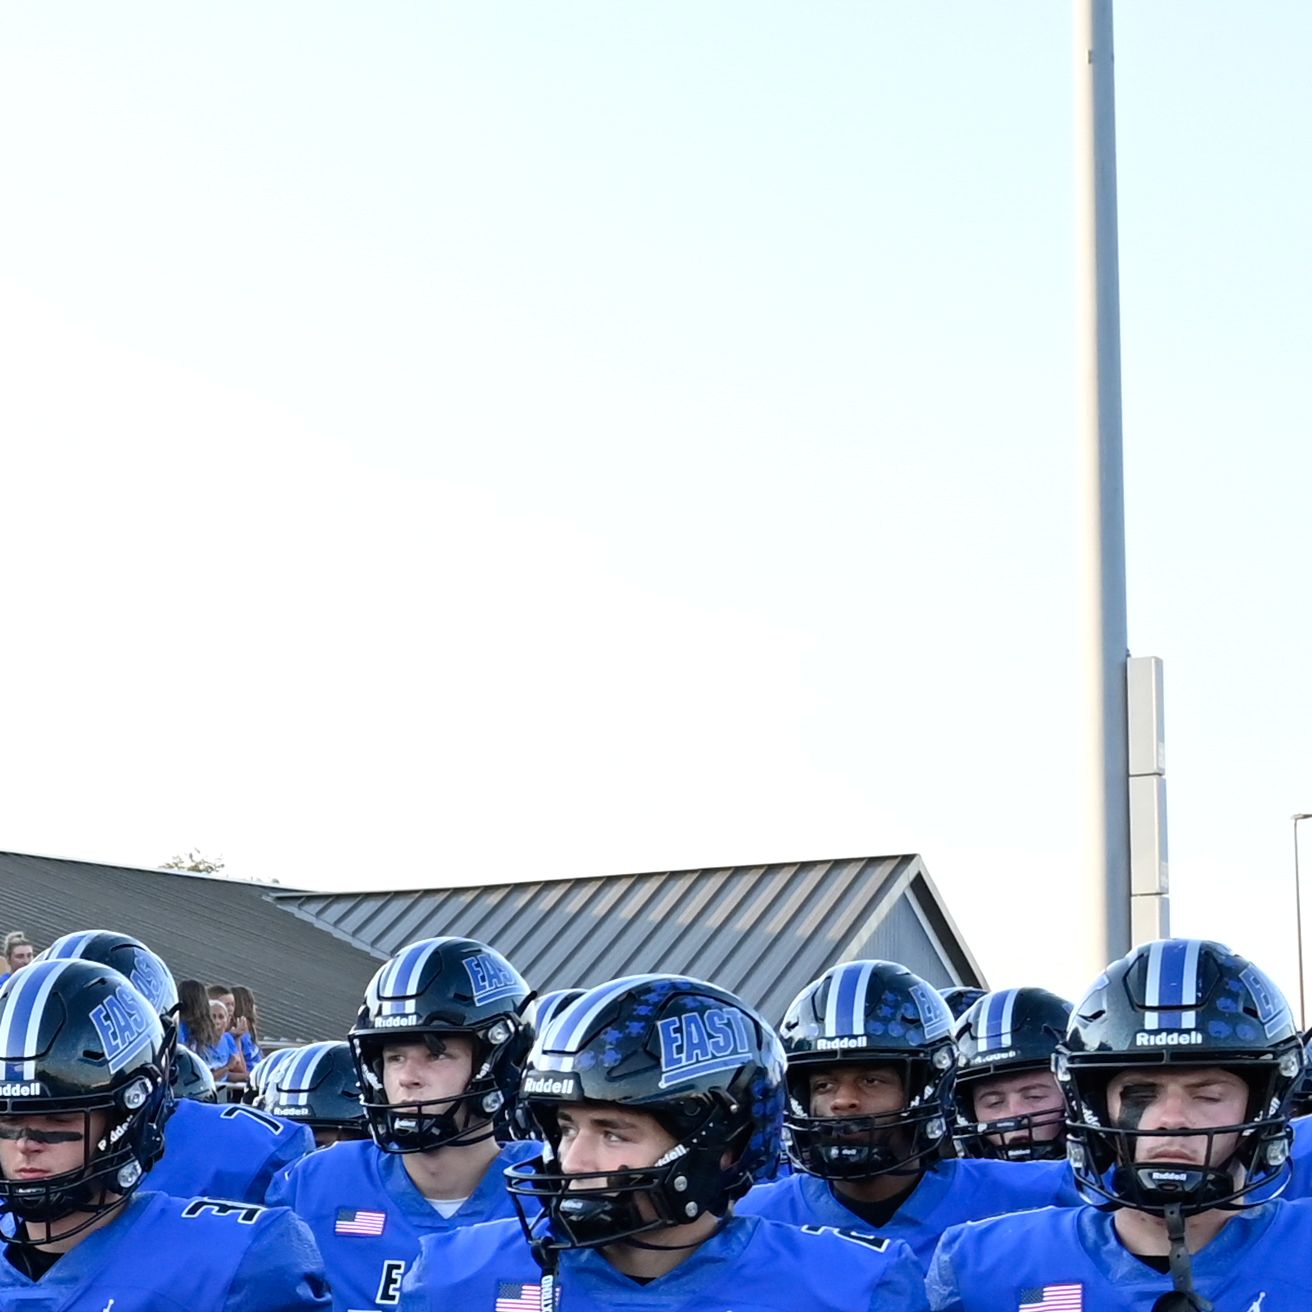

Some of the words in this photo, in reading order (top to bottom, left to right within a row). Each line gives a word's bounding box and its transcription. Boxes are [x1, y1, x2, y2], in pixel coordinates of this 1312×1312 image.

[461, 953, 518, 995] EAS
[88, 985, 144, 1058] EAS
[374, 1014, 417, 1028] Riddell
[656, 1007, 752, 1072] EAST
[816, 1036, 868, 1050] Riddell
[1135, 1031, 1203, 1046] Riddell
[523, 1077, 574, 1094] Riddell
